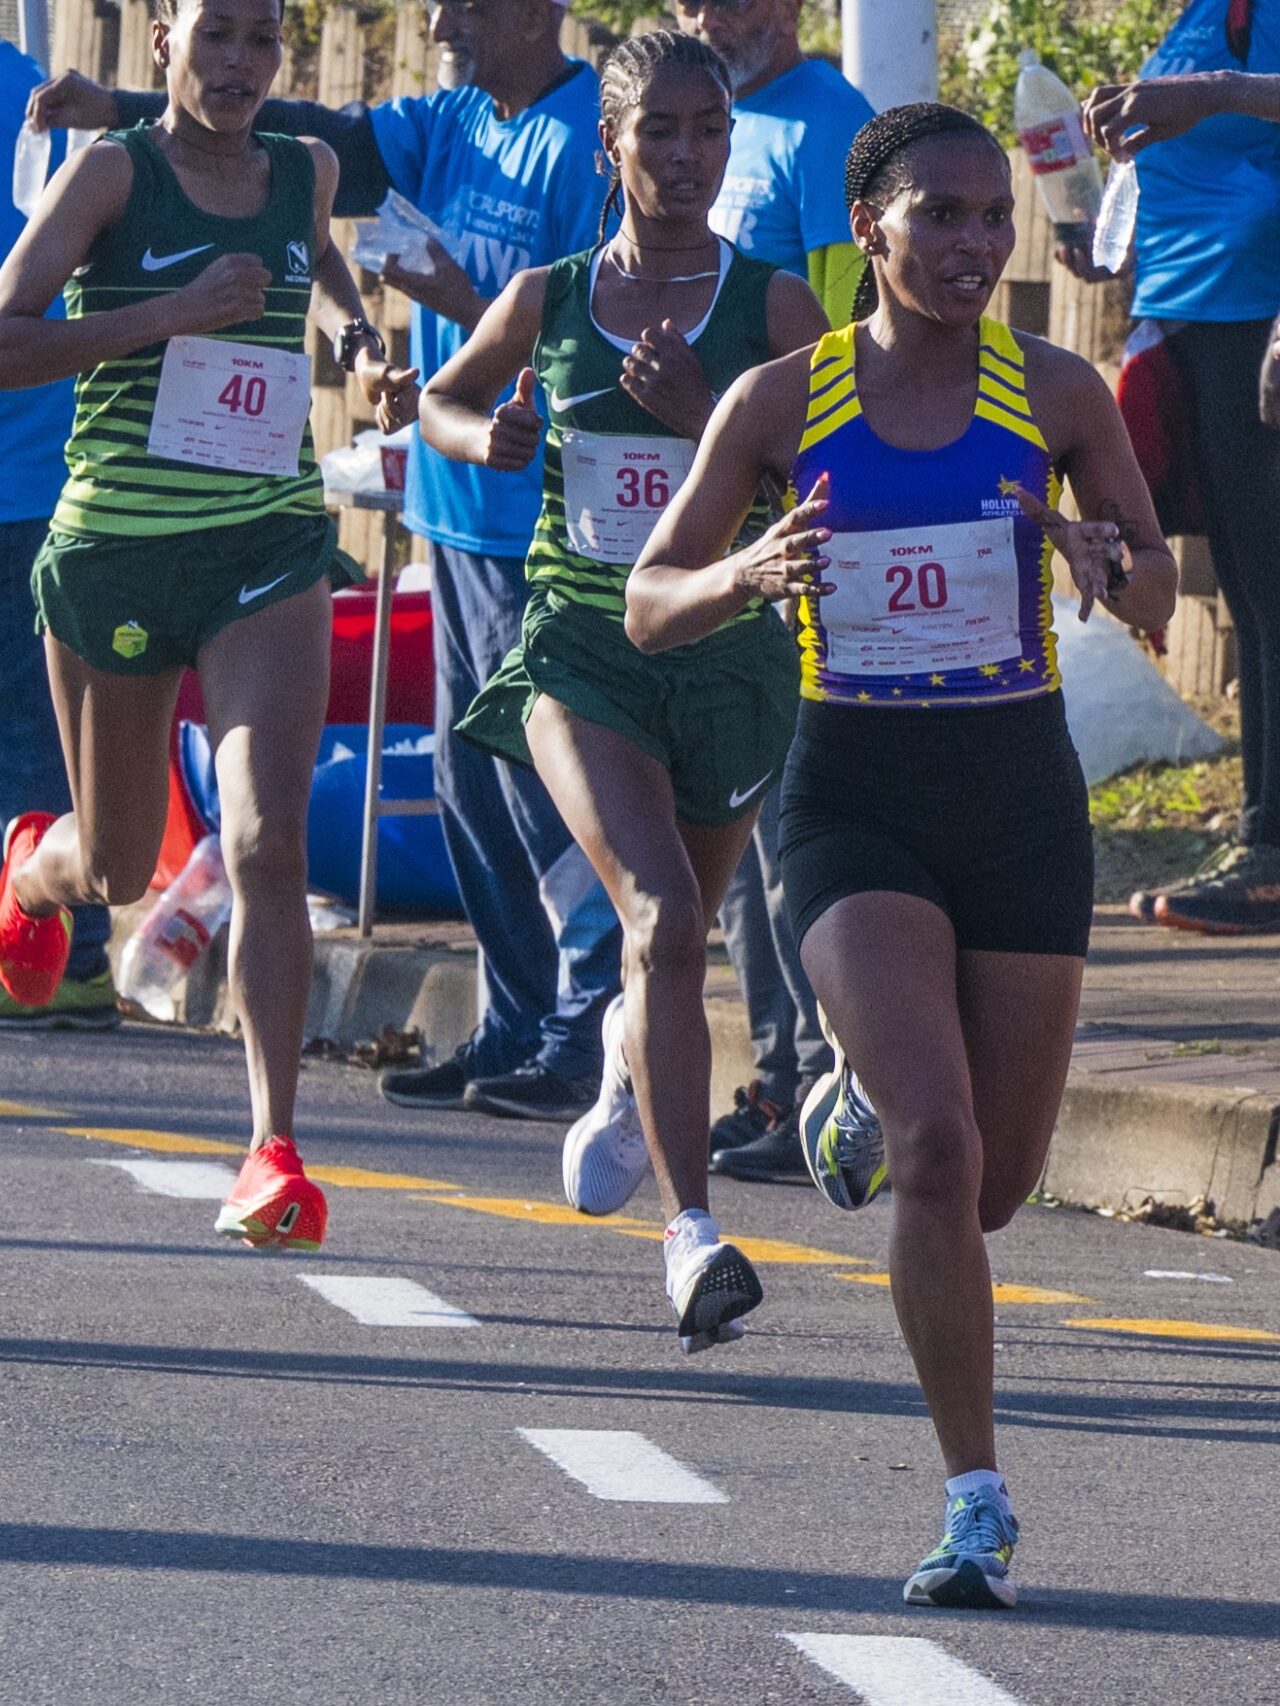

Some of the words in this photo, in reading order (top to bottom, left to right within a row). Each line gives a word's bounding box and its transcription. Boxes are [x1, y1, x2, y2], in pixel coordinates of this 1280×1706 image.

[231, 358, 264, 370] 10KM
[217, 374, 267, 417] 40
[623, 452, 660, 462] 10KM
[616, 467, 669, 508] 36
[981, 499, 1019, 510] HOLLYW
[889, 544, 934, 557] 10KM
[885, 562, 948, 613] 20
